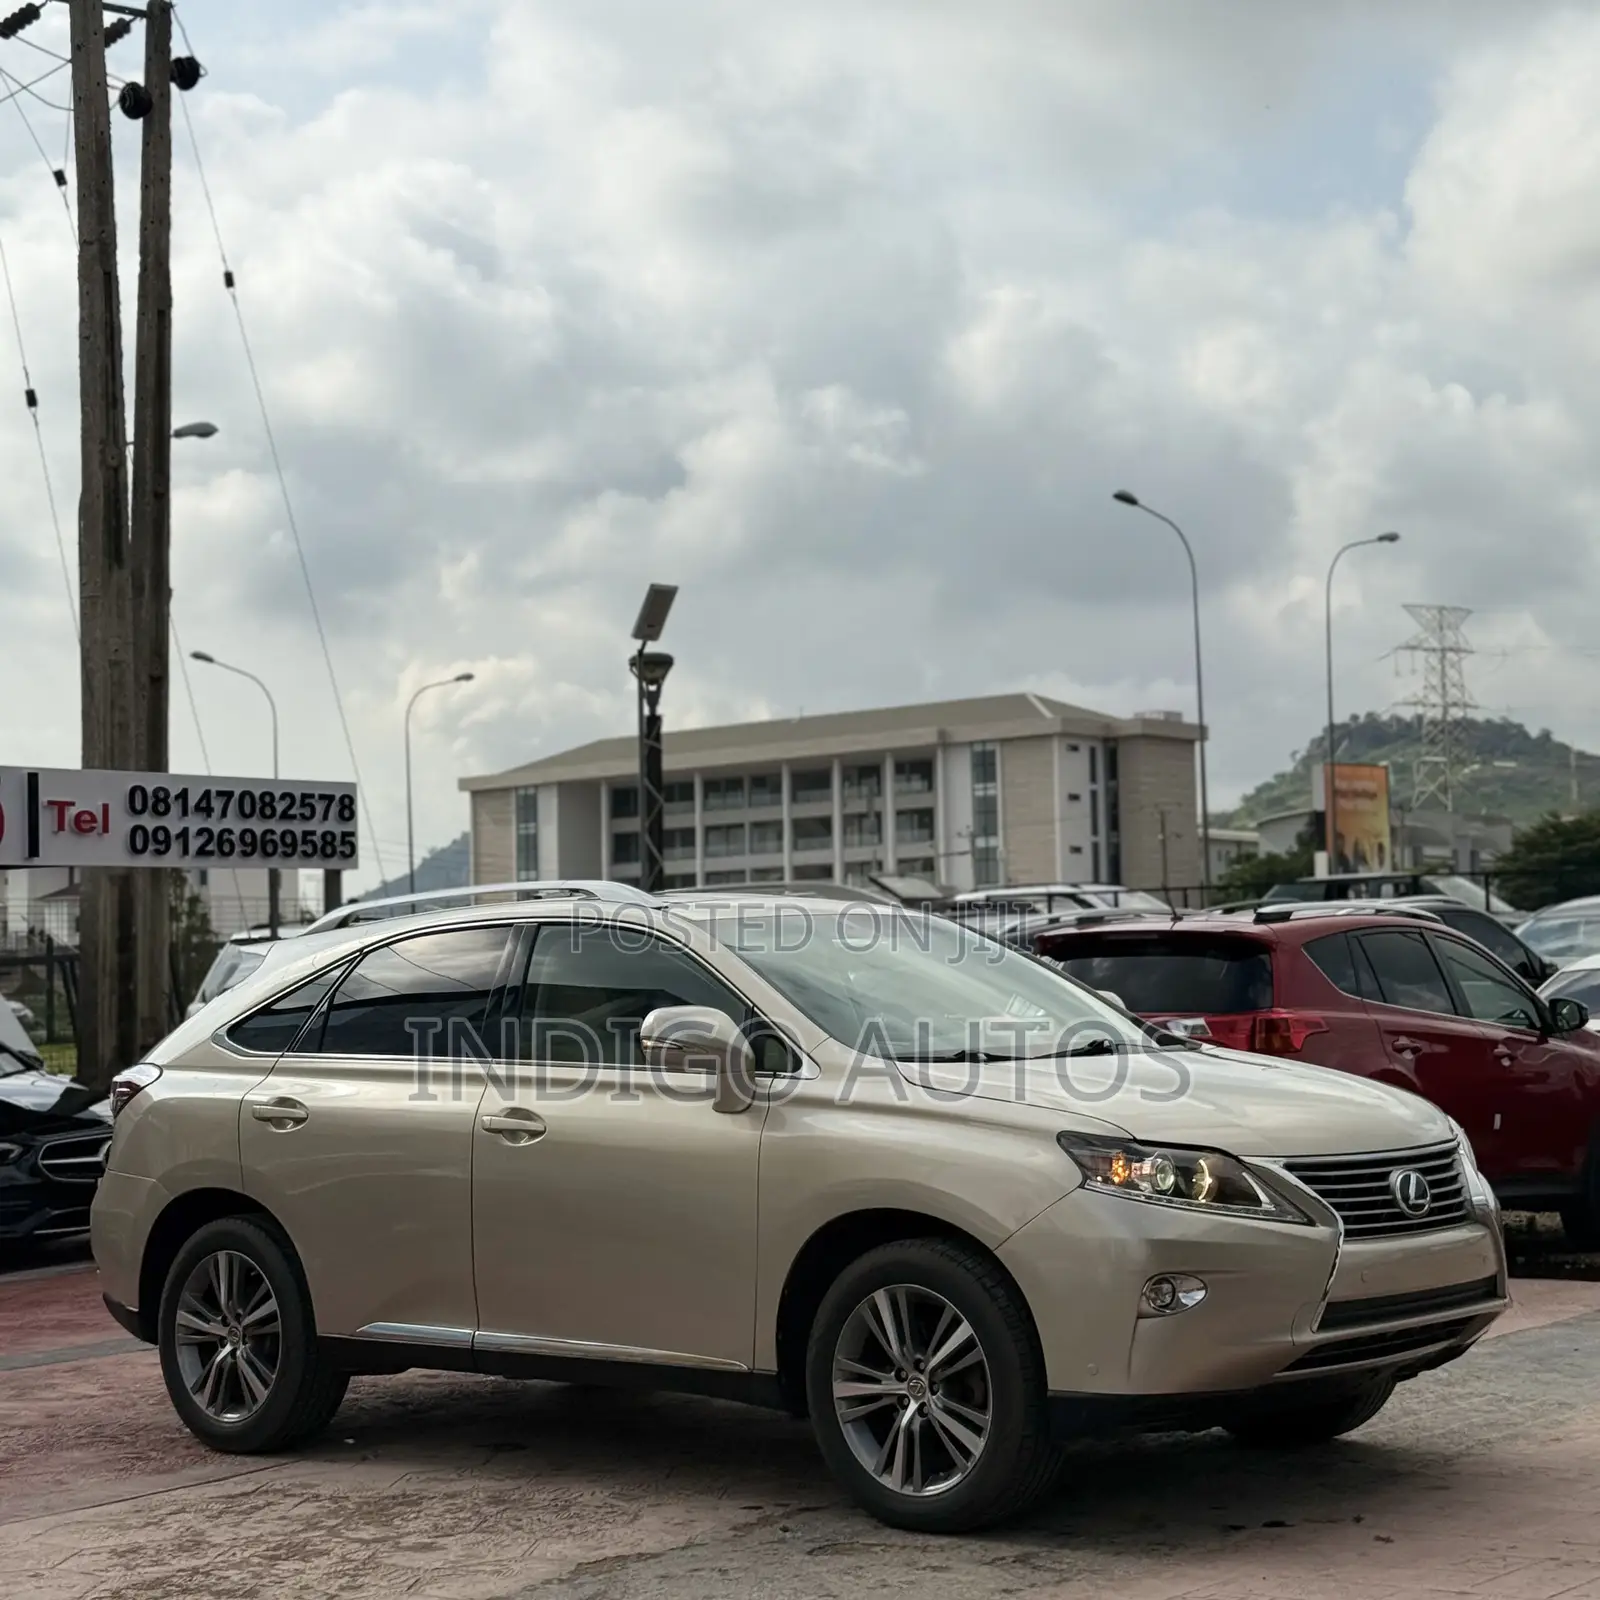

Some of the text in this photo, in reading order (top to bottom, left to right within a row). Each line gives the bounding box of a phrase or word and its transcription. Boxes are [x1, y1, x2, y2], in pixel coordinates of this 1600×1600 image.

[46, 799, 110, 835] Tel
[128, 784, 356, 822] 08147082578
[129, 824, 356, 860] 09126969585
